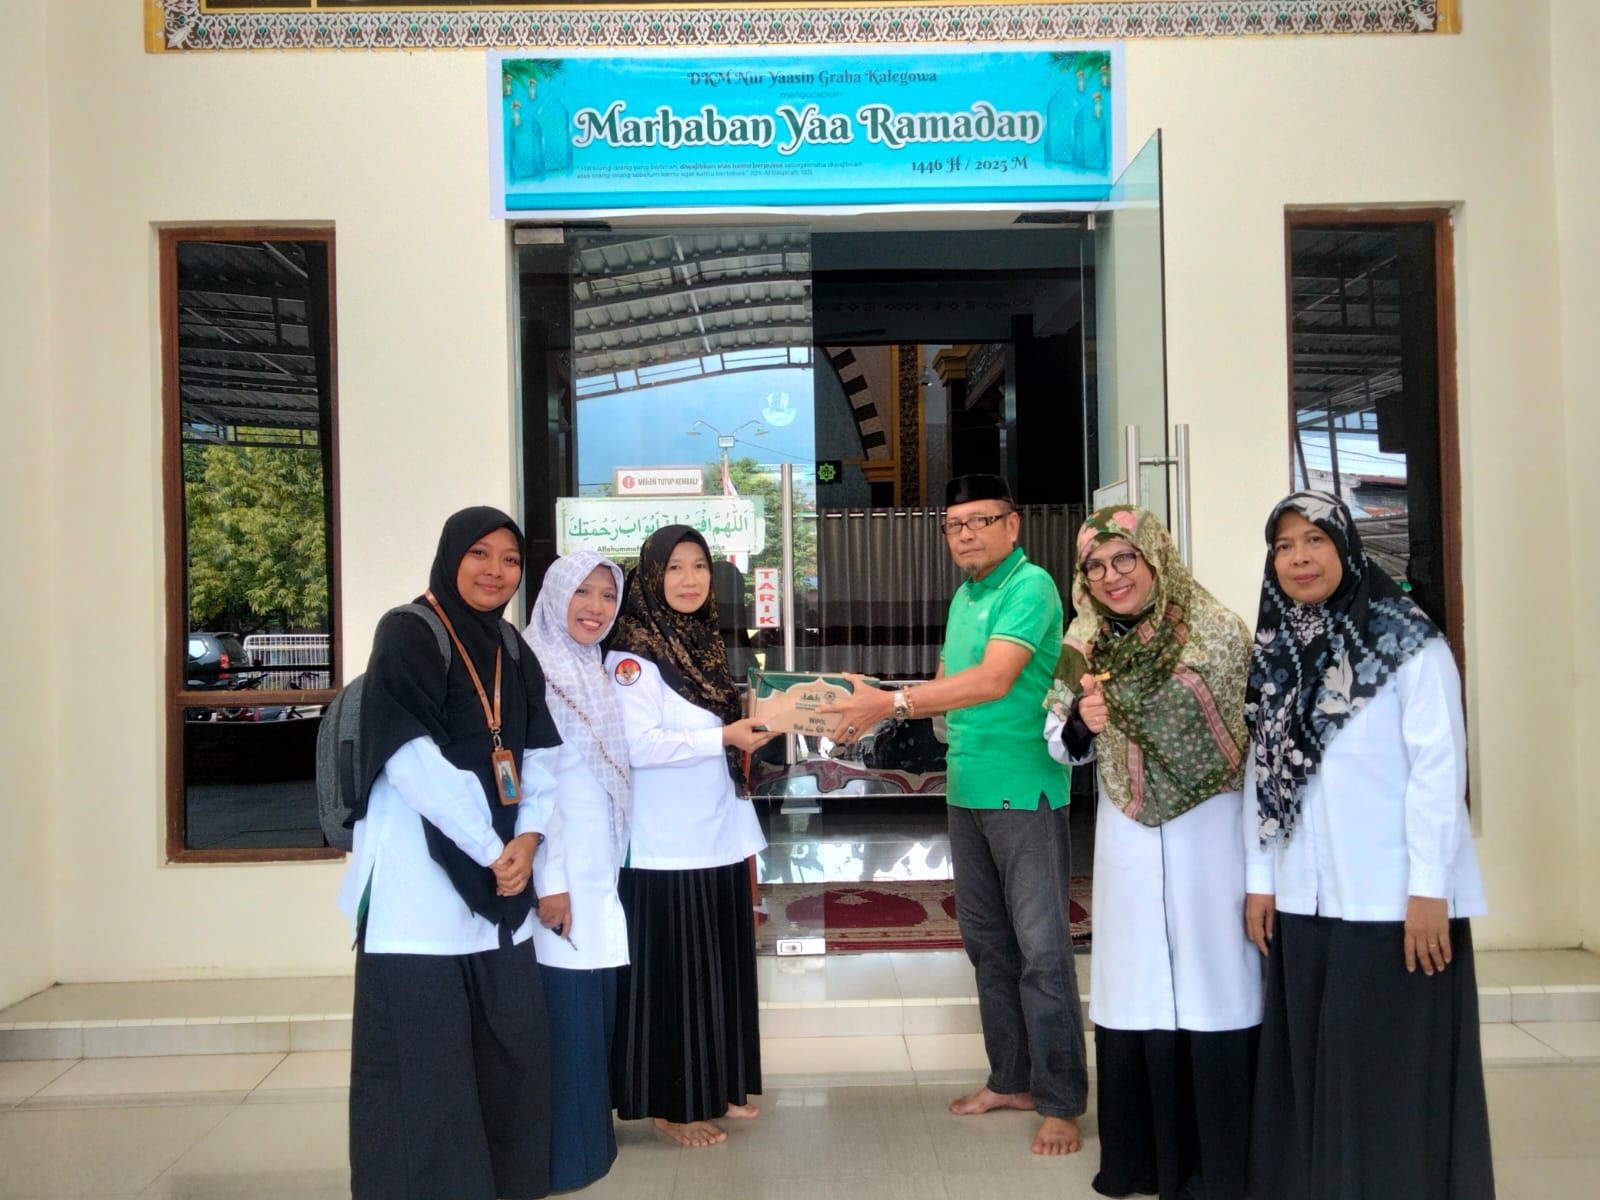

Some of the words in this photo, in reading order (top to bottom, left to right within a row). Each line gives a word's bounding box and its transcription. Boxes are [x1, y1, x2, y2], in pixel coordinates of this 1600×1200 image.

[687, 69, 732, 87] DKM
[735, 71, 763, 86] Nur
[767, 71, 814, 88] Yaasin
[818, 70, 861, 87] Graha
[865, 70, 937, 86] Kalegowa
[574, 102, 774, 148] Marhaban
[778, 106, 851, 153] Yaa
[858, 103, 1042, 147] Ramadan
[912, 160, 943, 174] 1446
[946, 155, 960, 173] H
[975, 159, 1008, 173] 2025
[1011, 155, 1028, 170] M
[758, 571, 776, 625] TARIK
